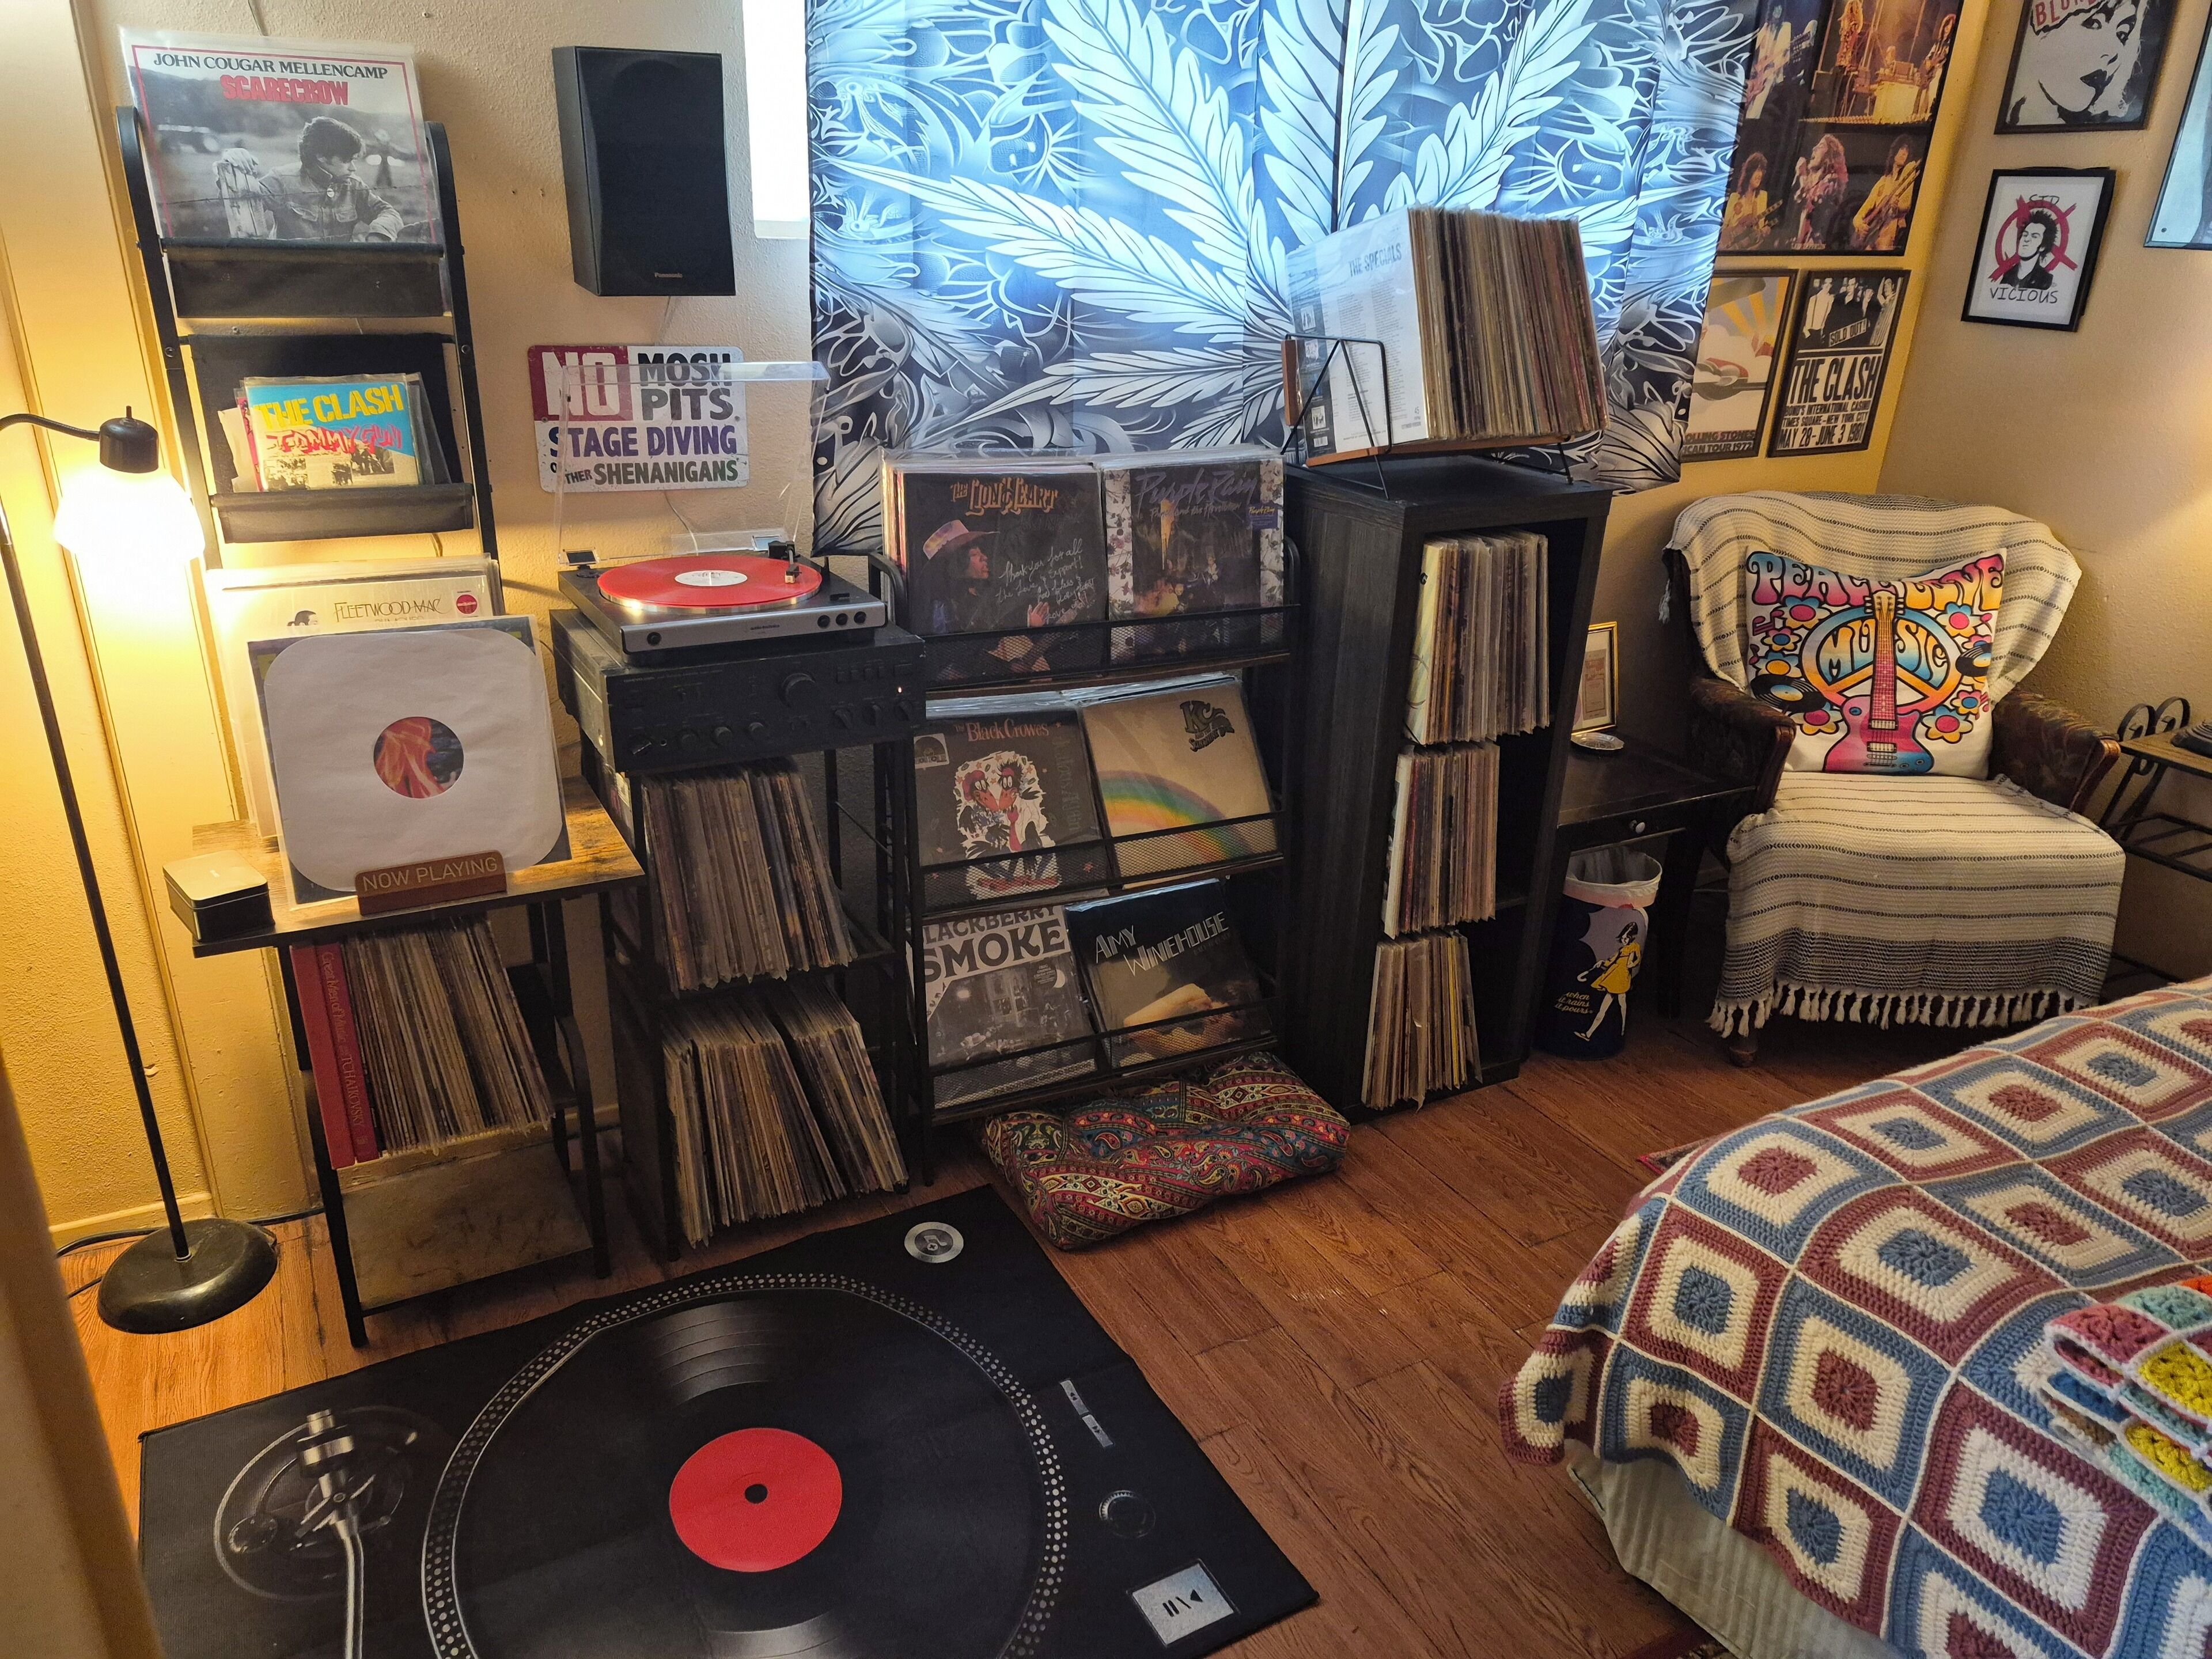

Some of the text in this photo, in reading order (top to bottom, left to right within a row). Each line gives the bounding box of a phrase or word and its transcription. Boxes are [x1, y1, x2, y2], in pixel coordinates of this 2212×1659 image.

[154, 53, 388, 79] JOHN COUGAR MELLENCAMP
[219, 74, 349, 105] SCARECROW
[1349, 243, 1402, 277] THE SPECIALS
[1990, 287, 2058, 304] VICIOUS
[1831, 320, 1866, 346] SOLD OUT!
[541, 352, 620, 416] NO
[638, 353, 733, 387] MOSH
[1790, 355, 1882, 404] THE CLASH
[254, 384, 404, 429] THE CLASH
[641, 388, 734, 421] PITS
[1806, 402, 1849, 415] INTERNATIONAL
[1782, 417, 1800, 428] TIMES
[1841, 413, 1854, 423] YORK
[1856, 411, 1868, 422] CITY
[266, 426, 359, 454] TOMMY
[548, 425, 737, 458] STAGE DIVING
[1685, 429, 1755, 442] OLLING STONES
[1707, 442, 1732, 453] TOUR
[1732, 441, 1752, 451] 1972
[1778, 428, 1798, 448] MAY
[1838, 424, 1846, 443] 3
[1847, 422, 1866, 442] 1981
[565, 460, 738, 486] THER SHENANIGANS
[1066, 538, 1083, 556] all
[334, 596, 451, 623] FLEETWOOD MAC
[1819, 618, 1950, 690] MUSIC
[966, 722, 1005, 742] Black
[1003, 719, 1050, 739] Crowes
[363, 857, 498, 892] NOW PLAYING
[923, 906, 1065, 983] LACKBERRY SMOKE
[1096, 925, 1137, 964] AMY
[1123, 911, 1224, 976] WINEHOUSE
[1563, 991, 1590, 1001] when
[1567, 999, 1590, 1007] rains
[321, 952, 339, 979] Great
[340, 1056, 365, 1127] TCHAIKOVSKY
